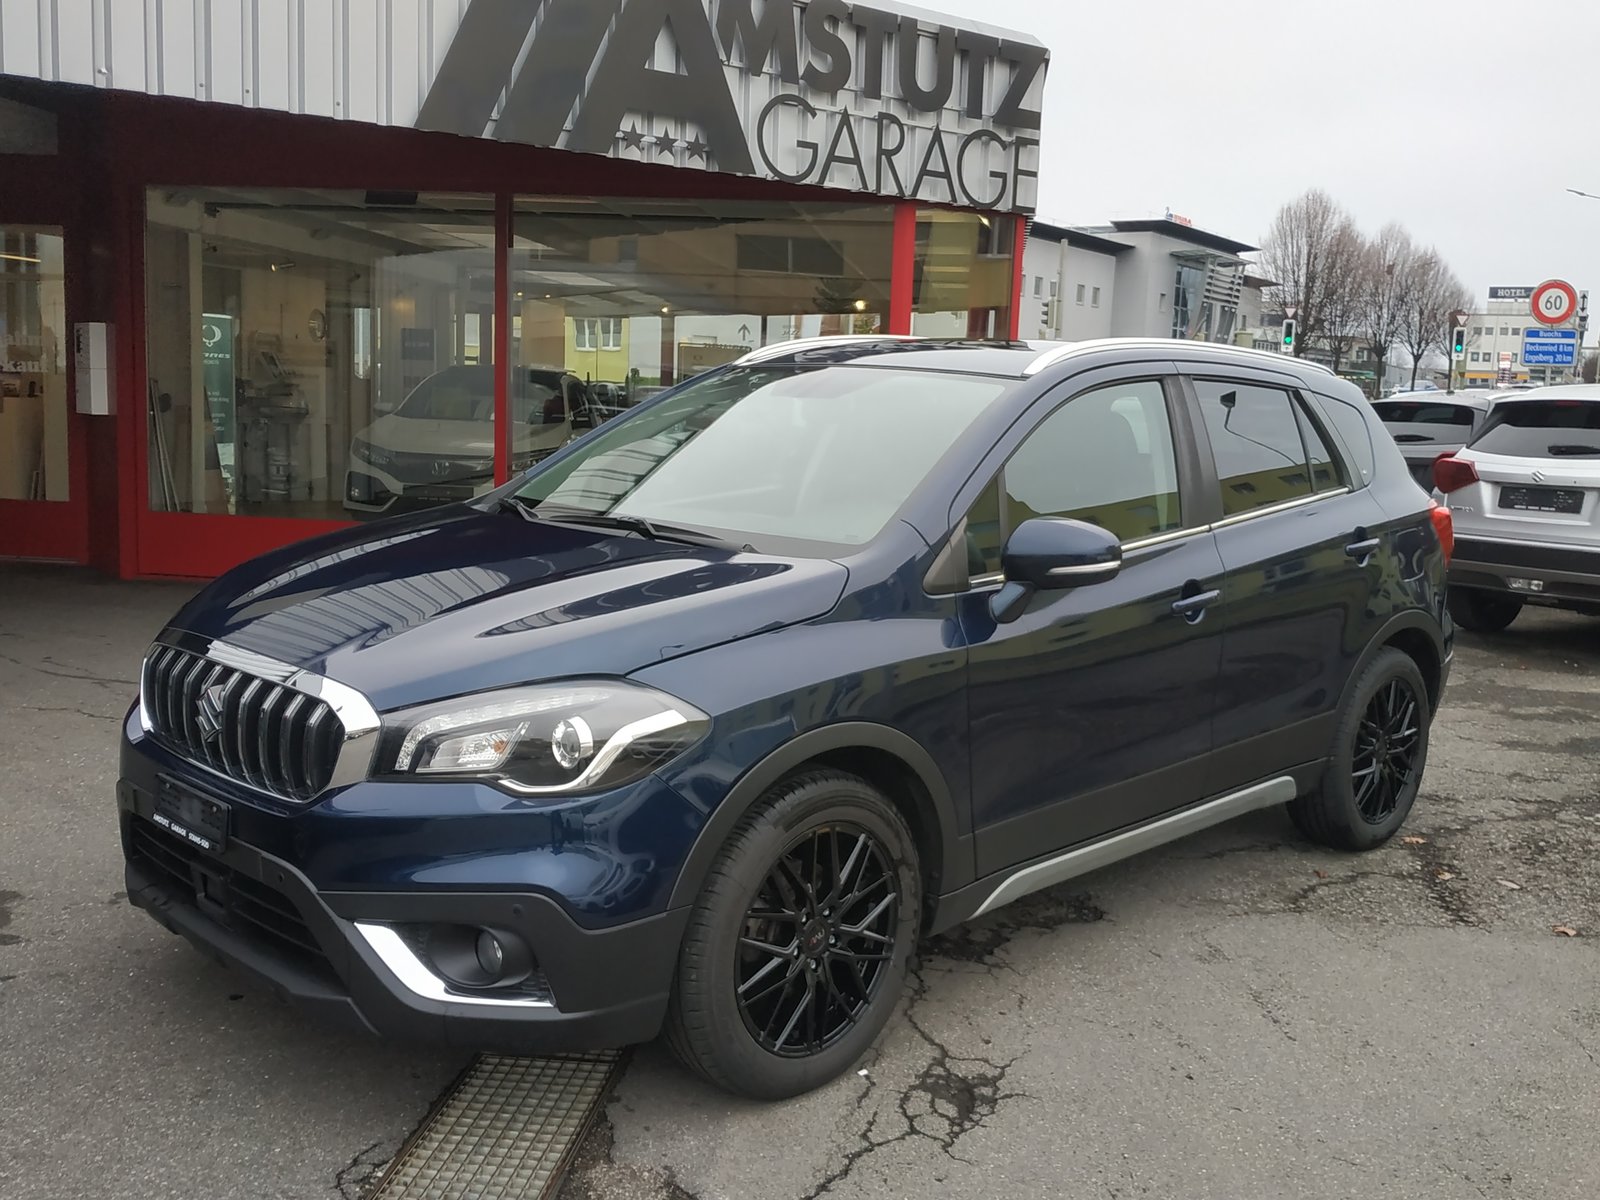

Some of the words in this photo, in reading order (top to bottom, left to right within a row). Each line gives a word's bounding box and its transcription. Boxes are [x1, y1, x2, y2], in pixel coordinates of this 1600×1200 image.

[756, 93, 1040, 214] GARAGE
[1497, 288, 1526, 297] HOTEL
[1544, 294, 1563, 311] 60
[1539, 330, 1562, 338] Buochs
[1526, 343, 1558, 352] Beckenried
[1525, 353, 1554, 363] Engelberg
[1555, 354, 1563, 362] 20
[1563, 354, 1573, 362] km
